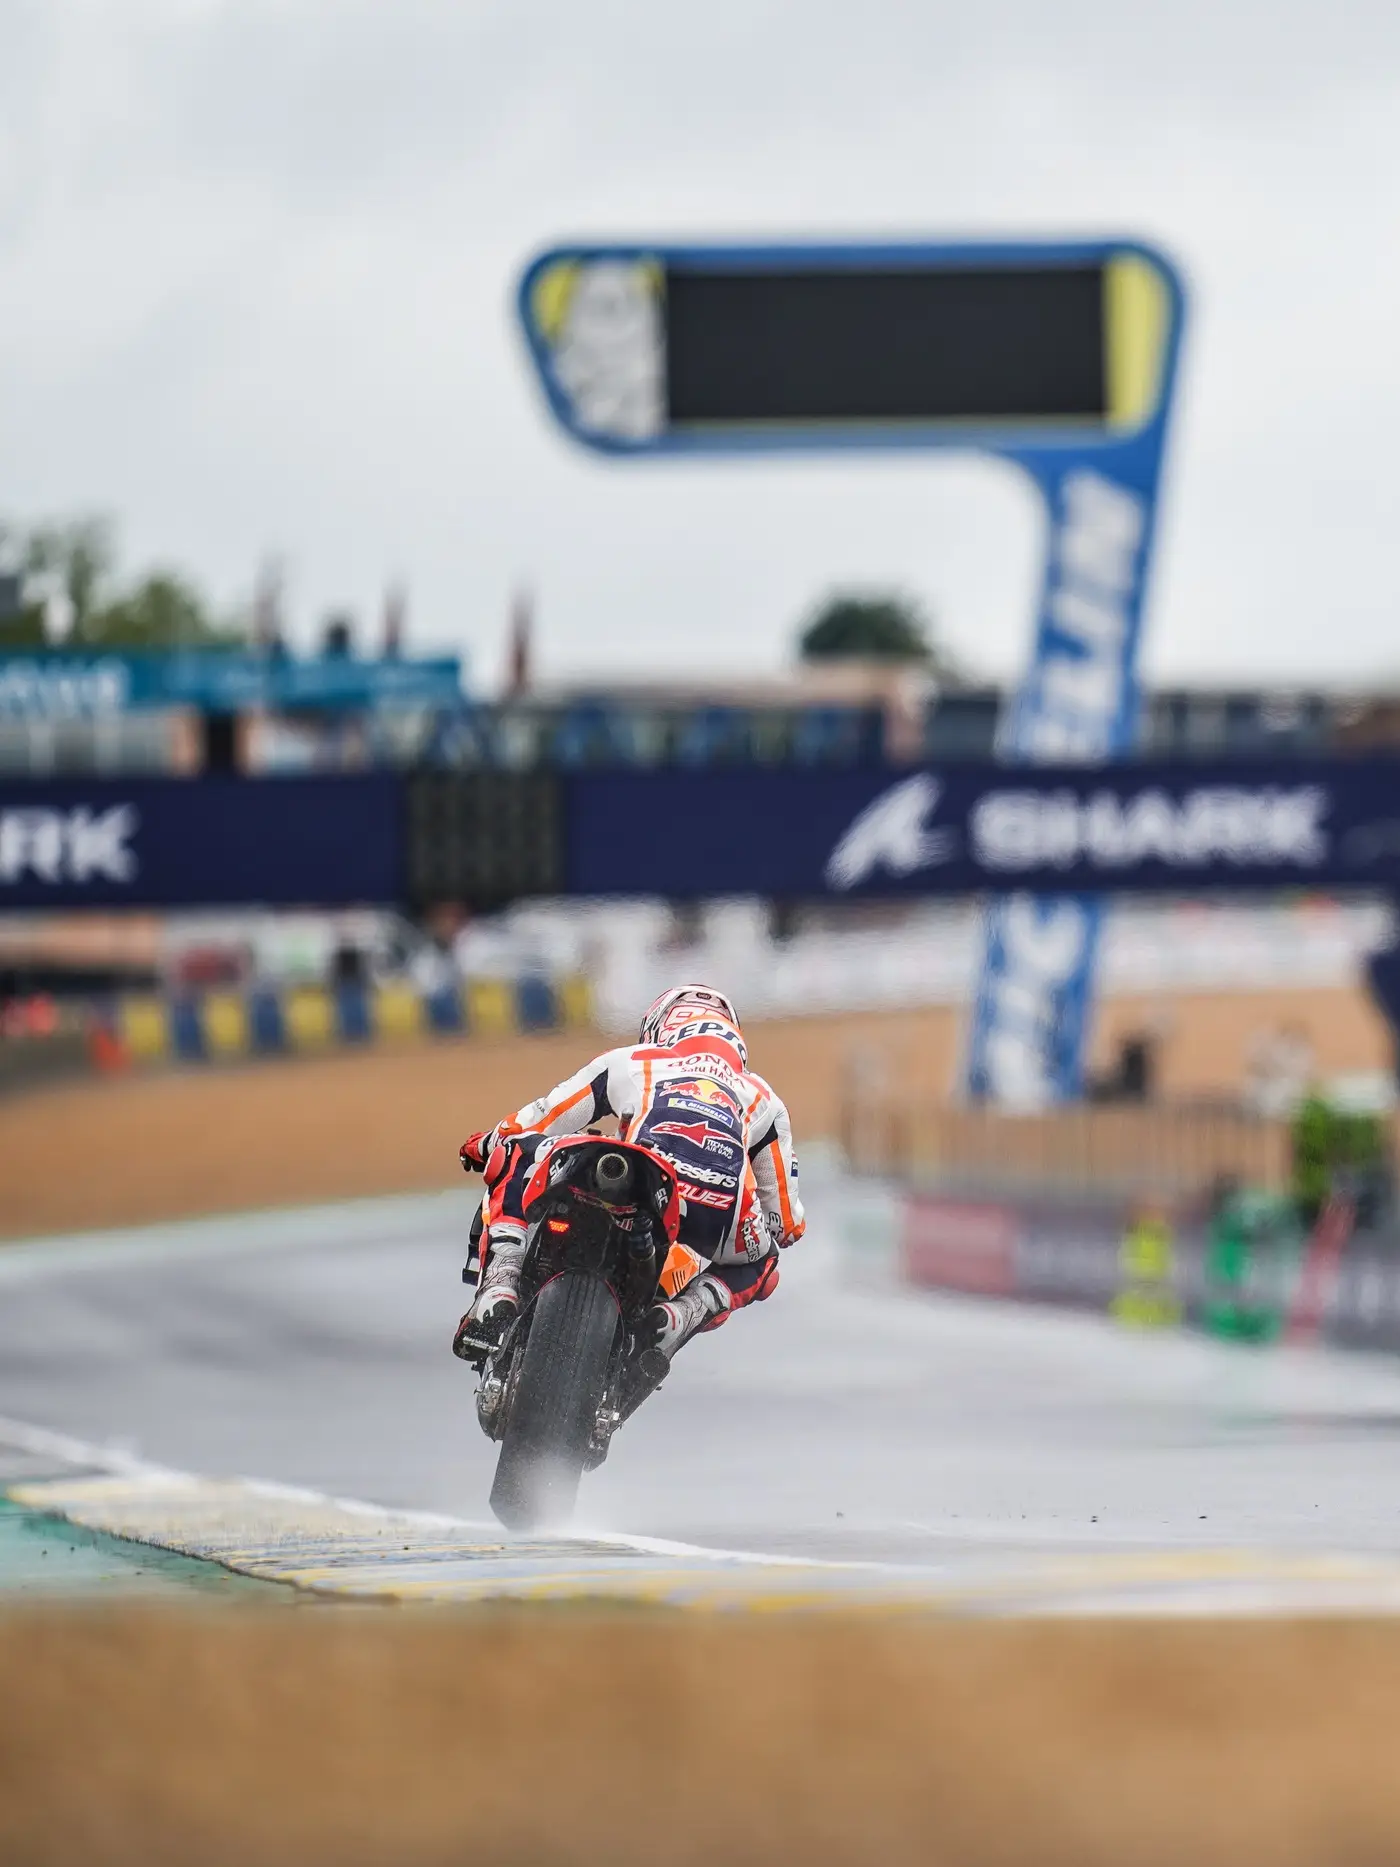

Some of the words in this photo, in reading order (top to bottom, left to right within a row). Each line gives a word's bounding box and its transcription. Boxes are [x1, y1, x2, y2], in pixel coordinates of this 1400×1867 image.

[972, 787, 1329, 872] SHARK
[681, 1065, 706, 1073] Satu
[687, 1100, 730, 1122] MICHELIN
